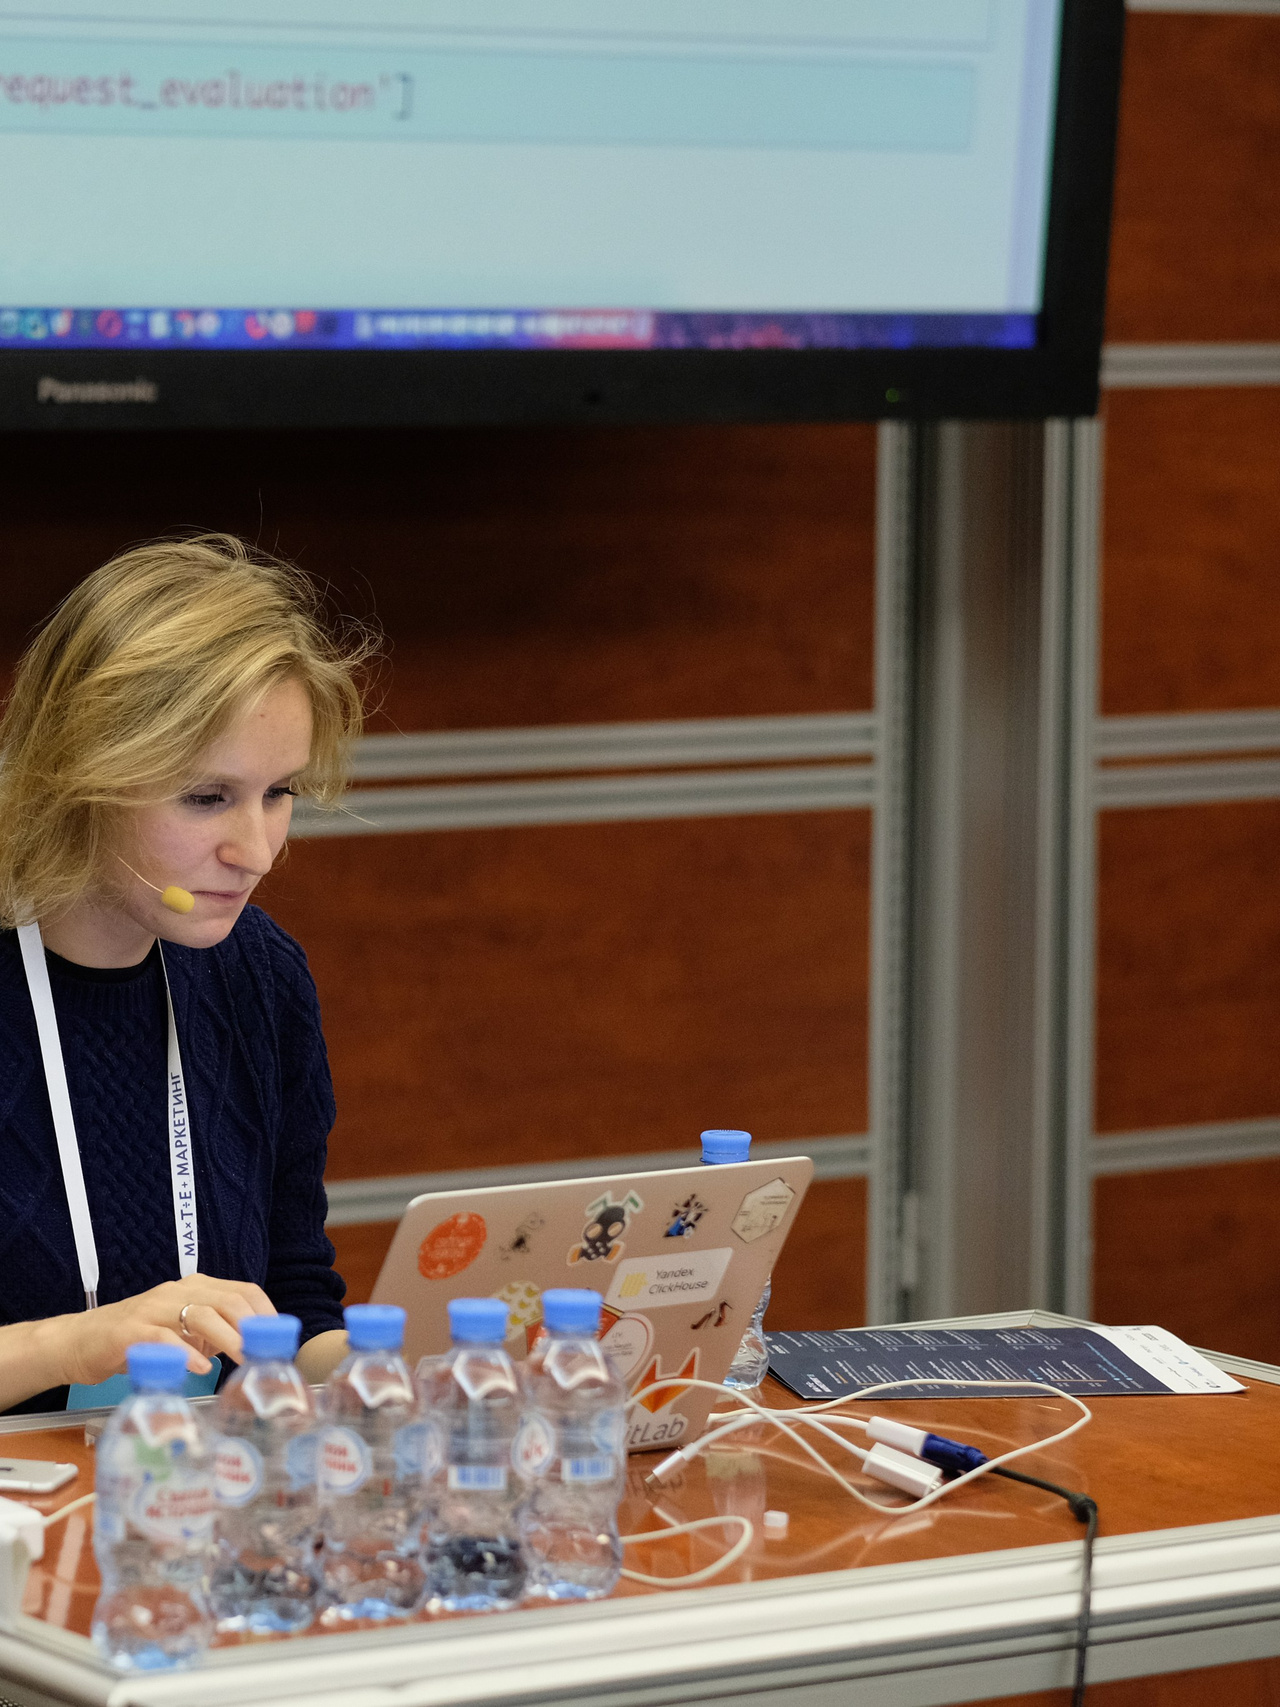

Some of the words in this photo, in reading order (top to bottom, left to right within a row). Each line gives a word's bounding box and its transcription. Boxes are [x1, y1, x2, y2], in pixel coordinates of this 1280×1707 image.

[170, 1072, 190, 1176] МАРКЕТИНГ
[656, 1268, 695, 1279] Yandex
[648, 1280, 708, 1294] ClickHouse
[626, 1417, 684, 1444] itLab
